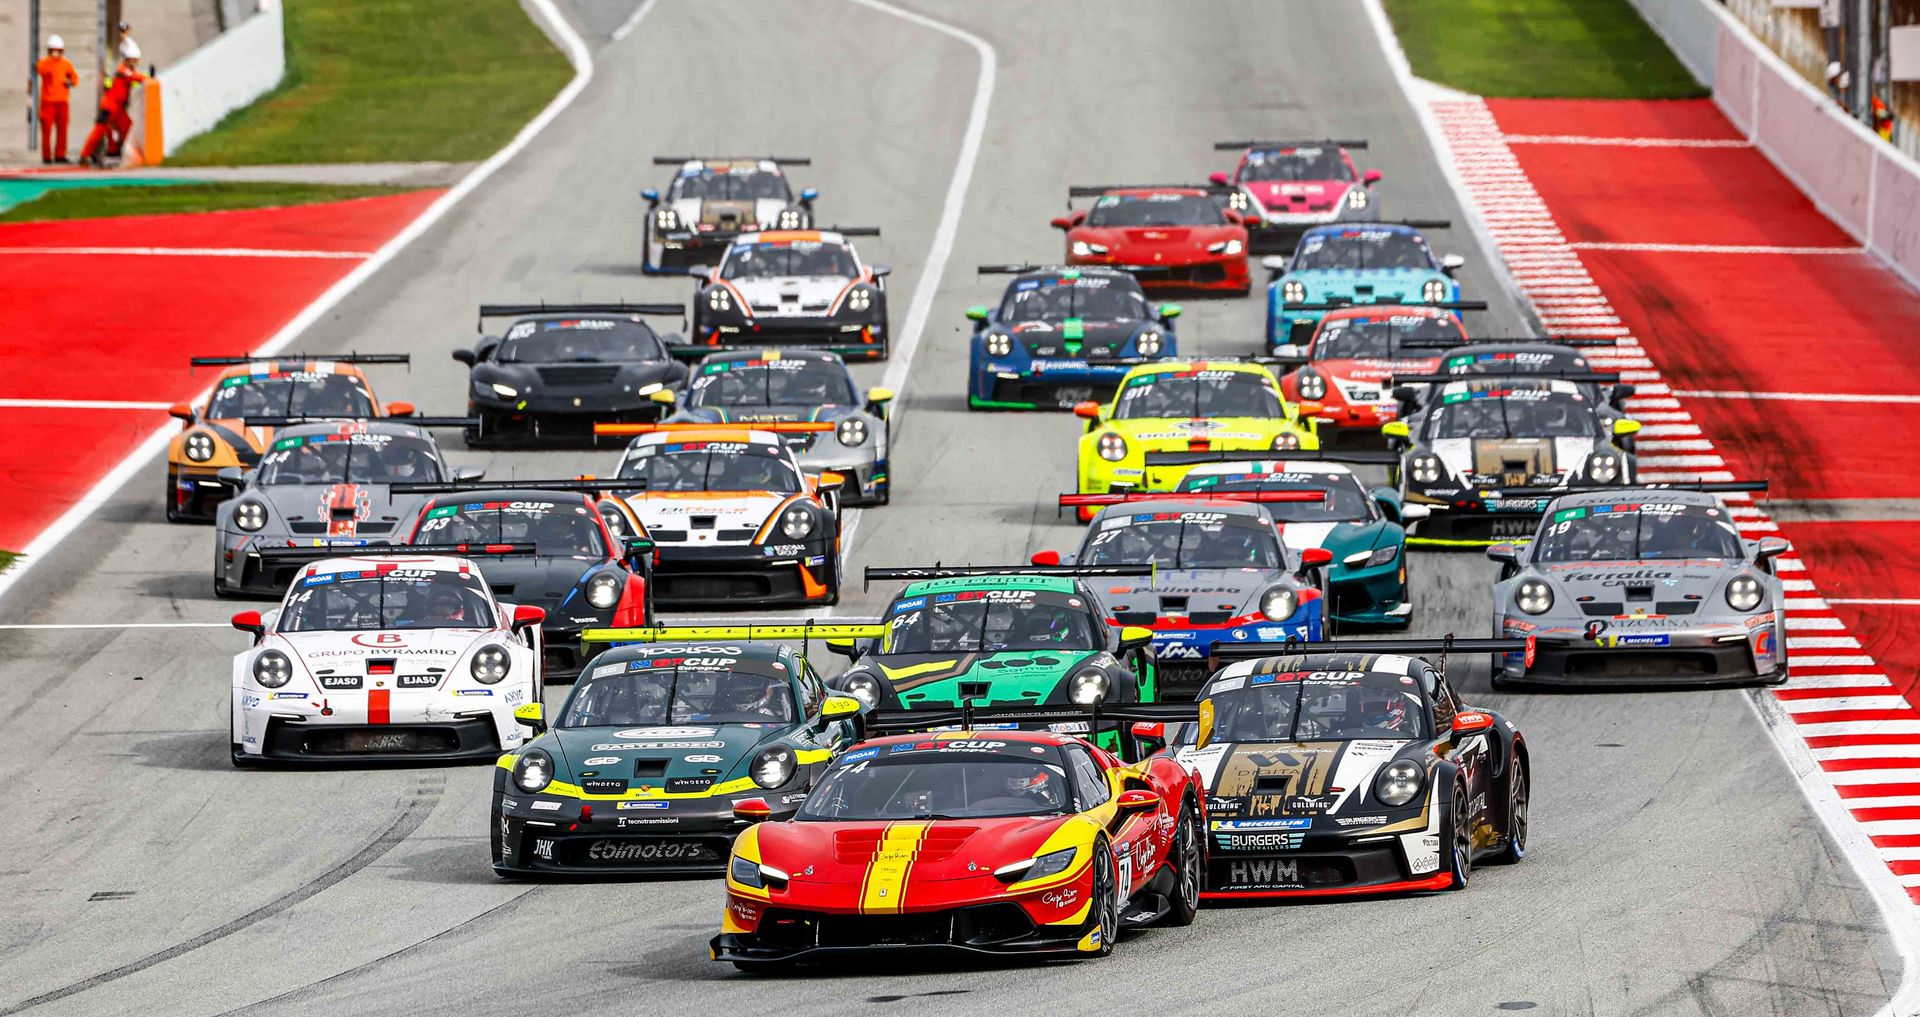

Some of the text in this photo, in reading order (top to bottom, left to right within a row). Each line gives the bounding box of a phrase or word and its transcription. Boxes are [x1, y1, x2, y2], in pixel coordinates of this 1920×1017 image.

[1125, 385, 1153, 400] 911
[422, 518, 451, 532] 83
[1547, 520, 1572, 537] 19
[1092, 530, 1122, 546] 27
[306, 575, 332, 584] PROAM
[287, 589, 314, 606] 14
[897, 600, 923, 611] PROAM
[891, 611, 921, 629] 64
[308, 650, 365, 659] GRUPO
[325, 677, 358, 686] EJASO
[404, 676, 437, 685] EJASO
[845, 750, 876, 762] PROAM
[834, 761, 870, 780] 74
[1292, 801, 1329, 809] GULLWING
[1238, 819, 1305, 828] MICHELIN
[1231, 834, 1289, 847] BURGERS
[534, 840, 555, 857] JHK
[1230, 860, 1298, 883] HWM
